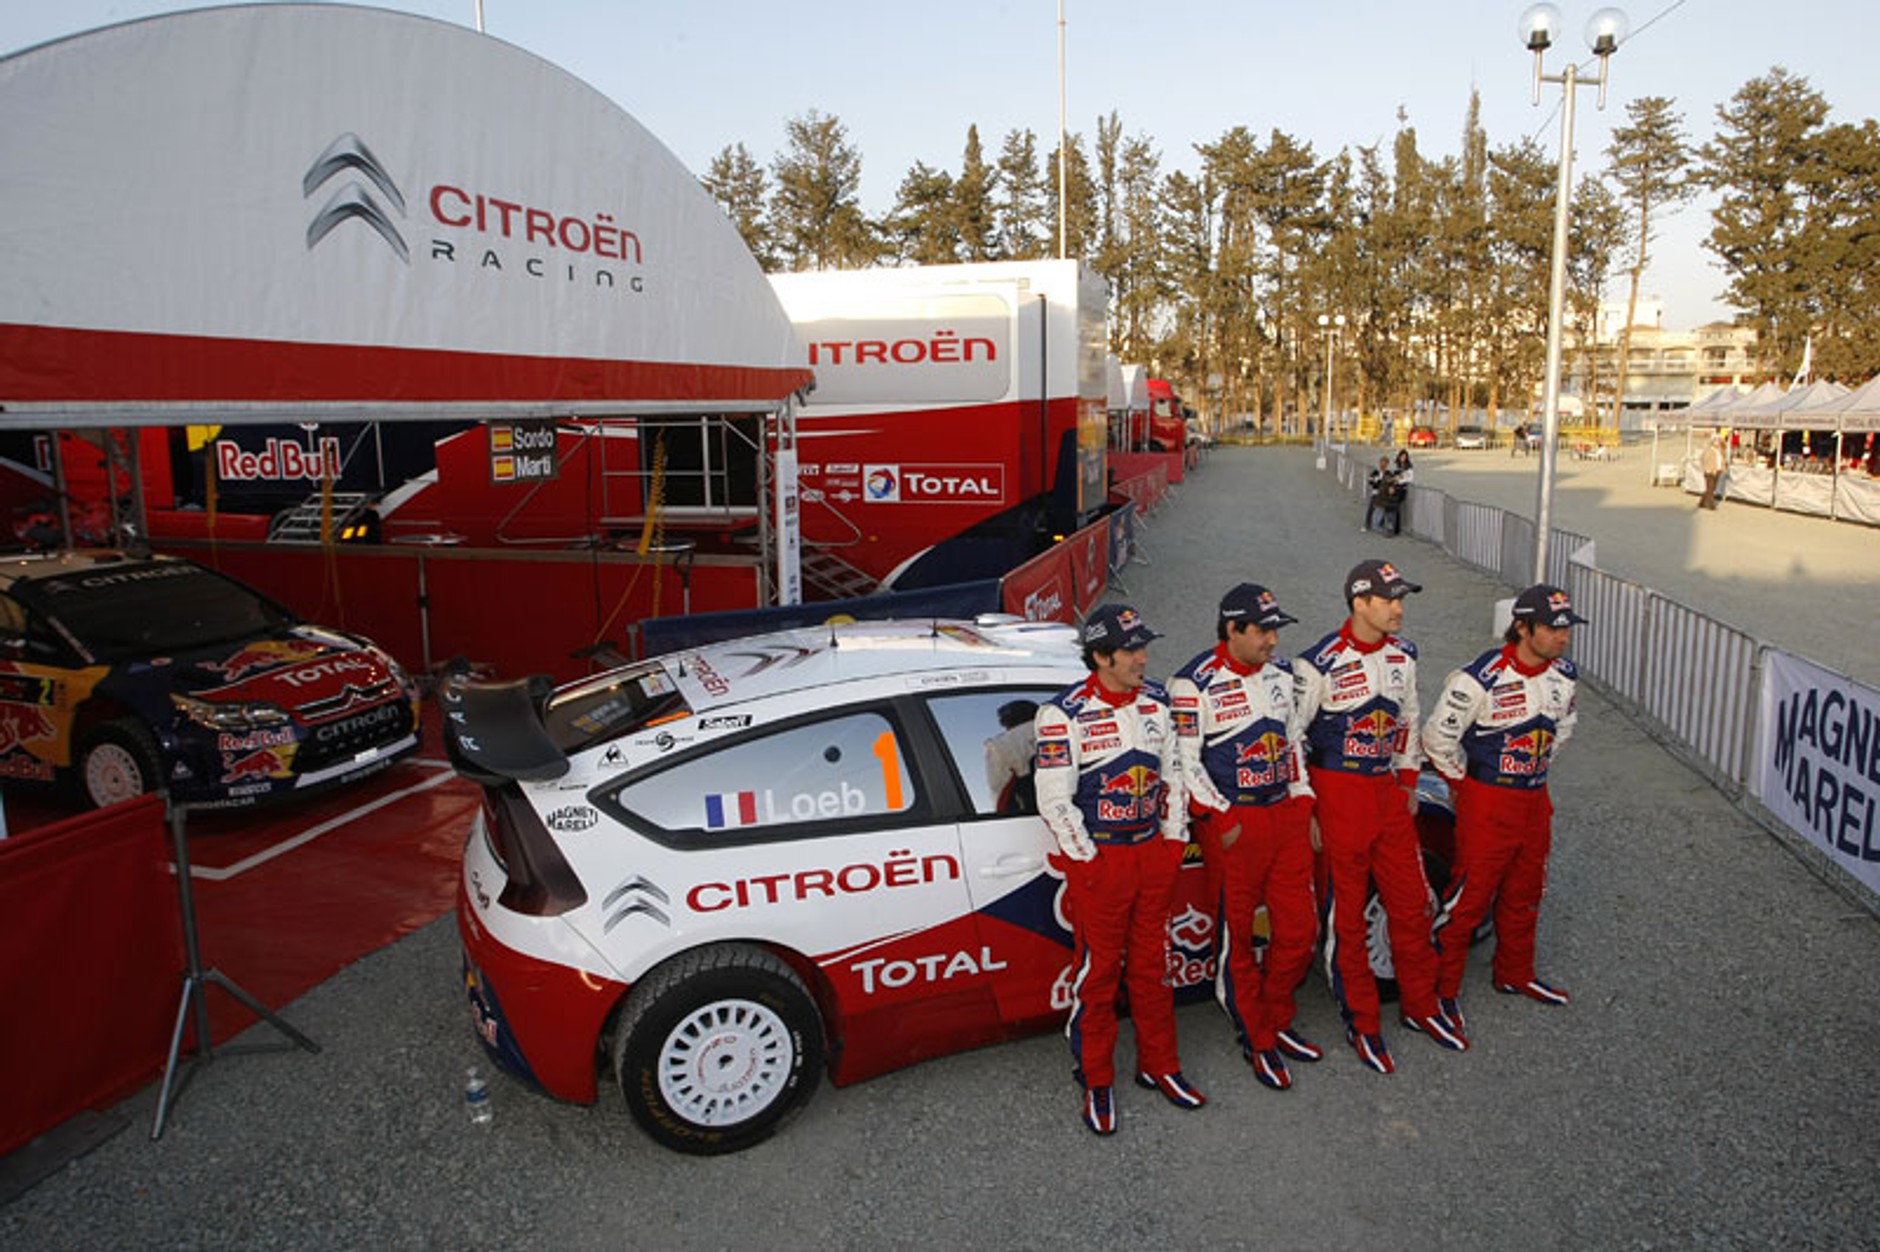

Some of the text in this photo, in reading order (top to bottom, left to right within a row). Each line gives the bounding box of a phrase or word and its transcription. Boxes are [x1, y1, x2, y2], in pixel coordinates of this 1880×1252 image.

[429, 184, 642, 265] CITROËN
[432, 240, 645, 293] RACING
[808, 330, 996, 366] ITROËN
[514, 426, 554, 449] Sordo
[216, 437, 342, 480] Red Bull
[904, 473, 998, 495] TOTAL
[273, 656, 372, 687] TOTAL
[317, 703, 400, 742] CITROËN
[873, 732, 904, 810] 1
[766, 781, 866, 821] Loeb
[1098, 798, 1139, 820] Red
[686, 849, 960, 913] CITROËN
[851, 945, 1008, 993] TOTAL
